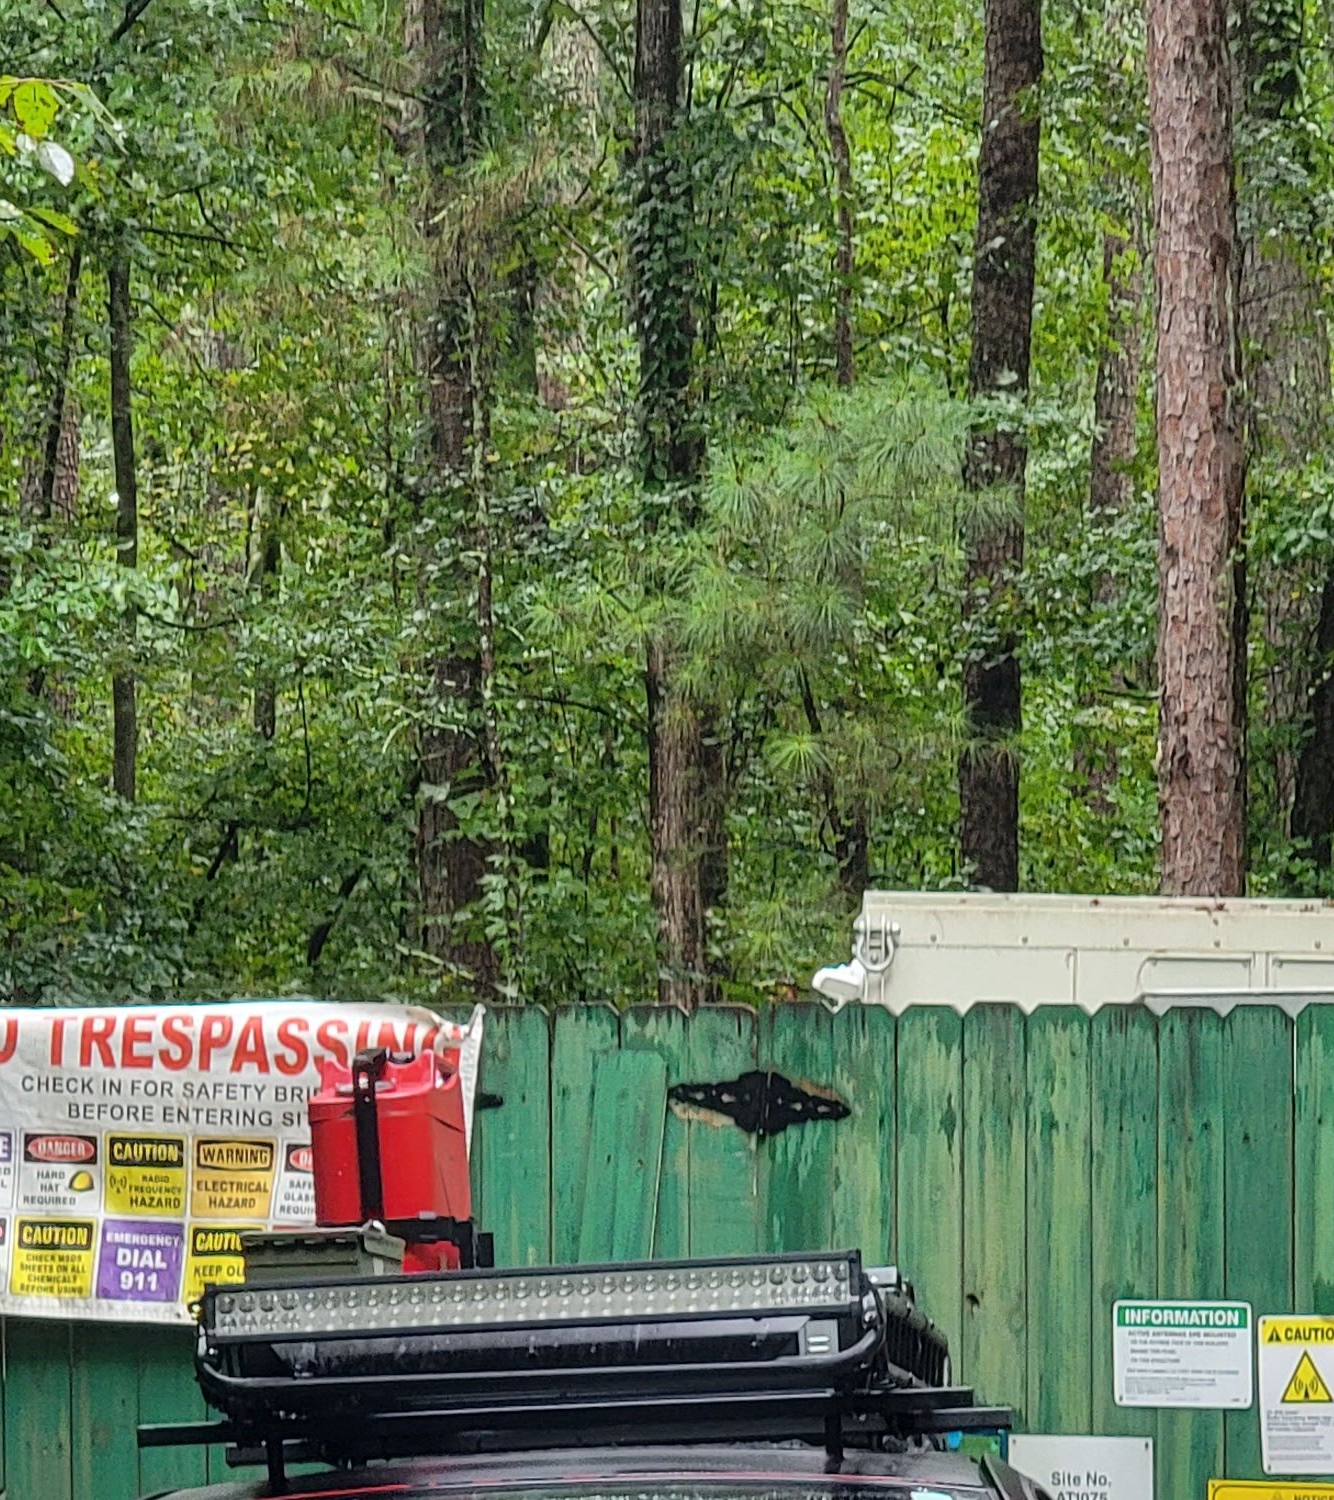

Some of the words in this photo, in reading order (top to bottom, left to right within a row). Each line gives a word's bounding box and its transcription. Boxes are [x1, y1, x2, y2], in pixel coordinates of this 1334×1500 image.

[21, 1075, 94, 1095] CHECK
[102, 1079, 122, 1096] IN
[130, 1080, 173, 1098] FOR
[182, 1081, 267, 1102] SAFETY
[68, 1103, 154, 1121] BEFORE
[162, 1106, 273, 1127] ENTERING
[37, 1141, 86, 1157] DANGER
[112, 1141, 179, 1162] CAUTION
[202, 1148, 268, 1164] WARNING
[196, 1180, 269, 1193] ELECTRICAL
[130, 1196, 181, 1209] HAZARD
[208, 1196, 256, 1209] HAZARD
[22, 1226, 88, 1246] CAUTION
[116, 1248, 167, 1269] DIAL
[193, 1264, 223, 1277] KEEP
[120, 1271, 158, 1292] 911
[1124, 1308, 1239, 1326] INFORMATION
[1051, 1471, 1081, 1486] Site
